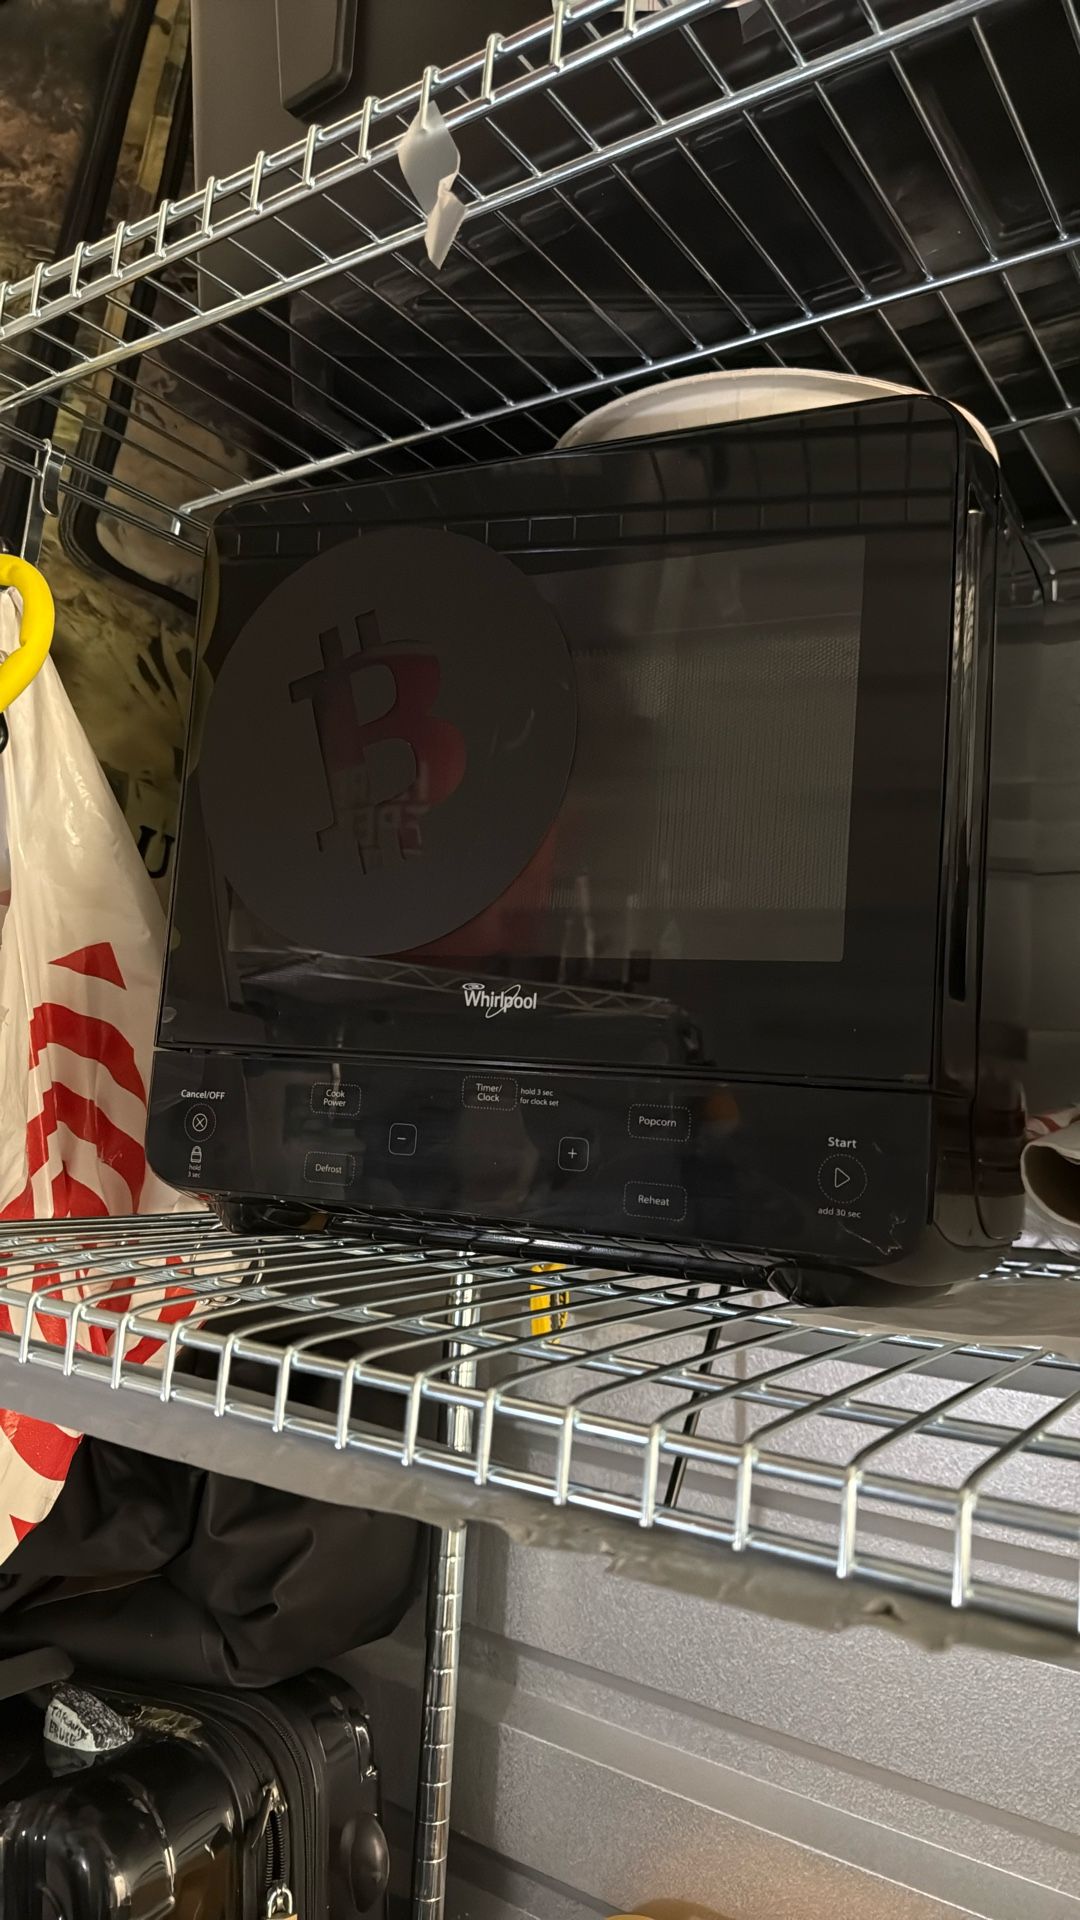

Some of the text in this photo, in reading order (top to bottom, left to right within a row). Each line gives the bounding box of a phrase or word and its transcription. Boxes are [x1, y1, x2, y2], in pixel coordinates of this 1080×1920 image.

[463, 986, 538, 1014] Whirlpool
[325, 1088, 346, 1098] Cook
[476, 1082, 503, 1093] Timer/
[520, 1087, 536, 1096] hold
[542, 1089, 554, 1097] sec
[180, 1088, 226, 1100] Cancel/OFF
[477, 1092, 500, 1103] Clock
[323, 1097, 347, 1107] Power
[519, 1096, 560, 1108] for clock set
[638, 1115, 678, 1128] Popcorn
[827, 1136, 857, 1149] Start
[315, 1163, 343, 1175] Defrost
[637, 1194, 671, 1207] Reheat
[817, 1207, 862, 1219] add 30 sec
